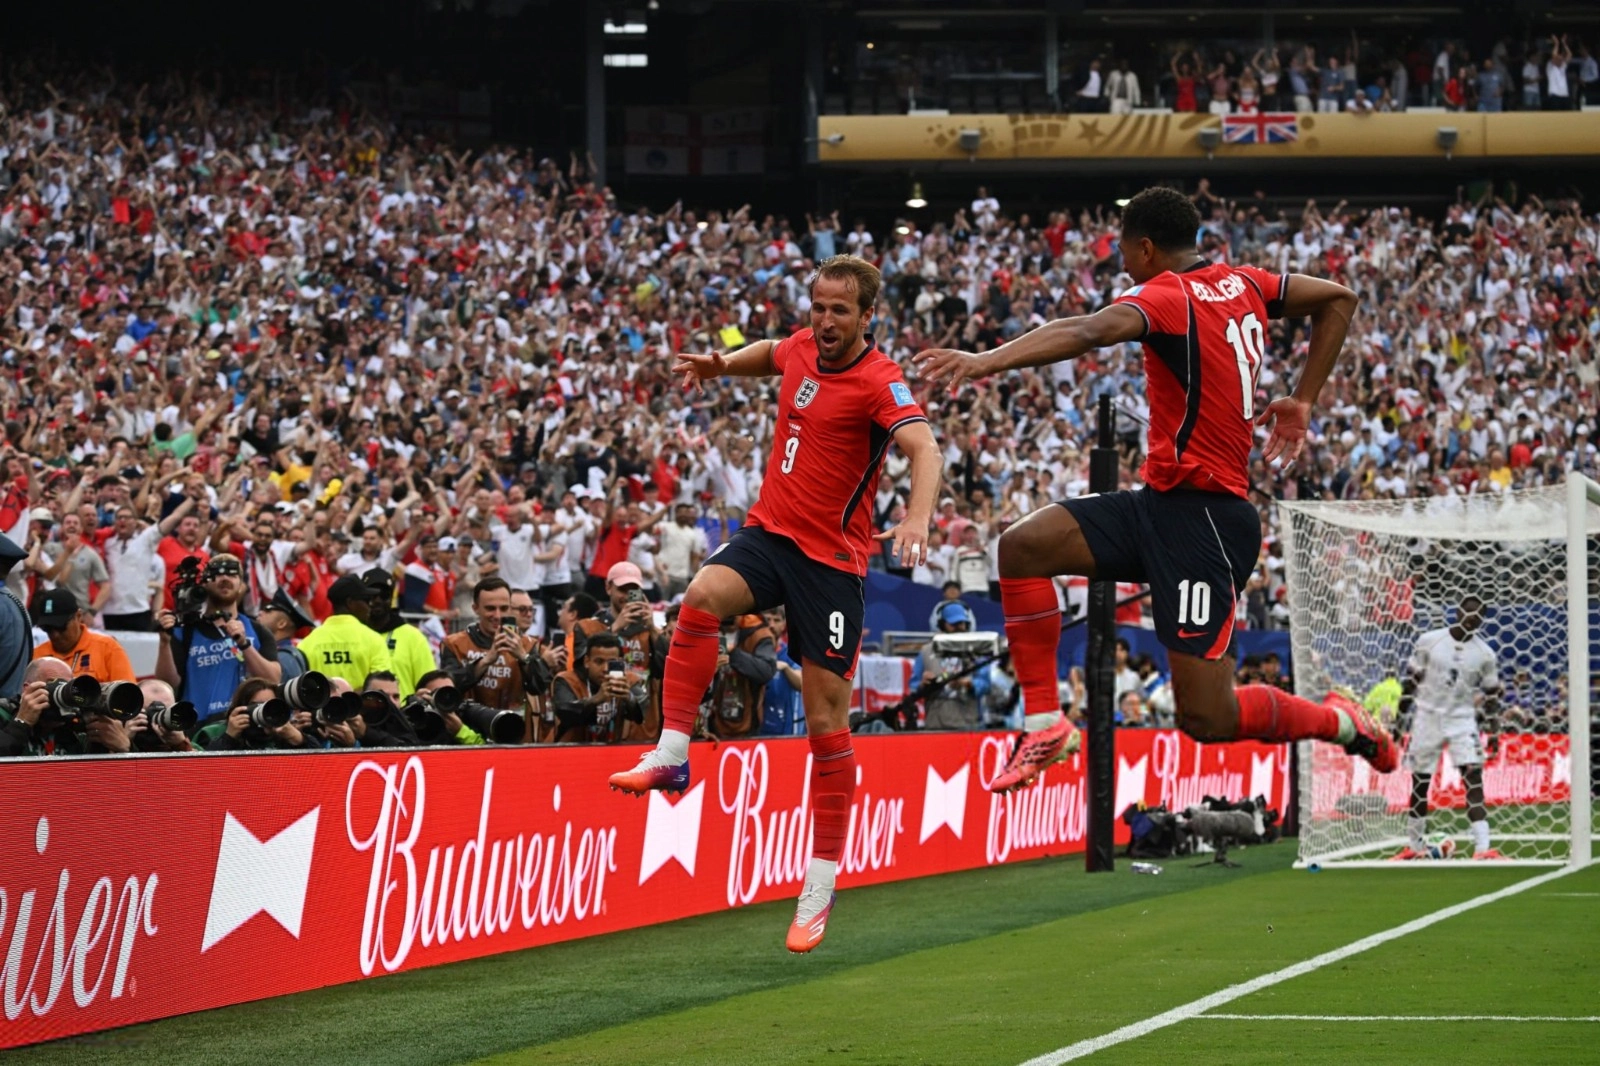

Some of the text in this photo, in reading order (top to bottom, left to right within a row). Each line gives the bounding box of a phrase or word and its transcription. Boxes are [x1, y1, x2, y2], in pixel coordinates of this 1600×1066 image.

[1226, 312, 1264, 420] 10
[781, 437, 799, 474] 9
[829, 611, 844, 649] 9
[1178, 580, 1210, 626] 10
[323, 651, 353, 665] 151
[718, 742, 904, 907] Budiser
[979, 733, 1087, 864] Budweis
[0, 816, 159, 1020] iser
[345, 755, 617, 976] Budweiser
